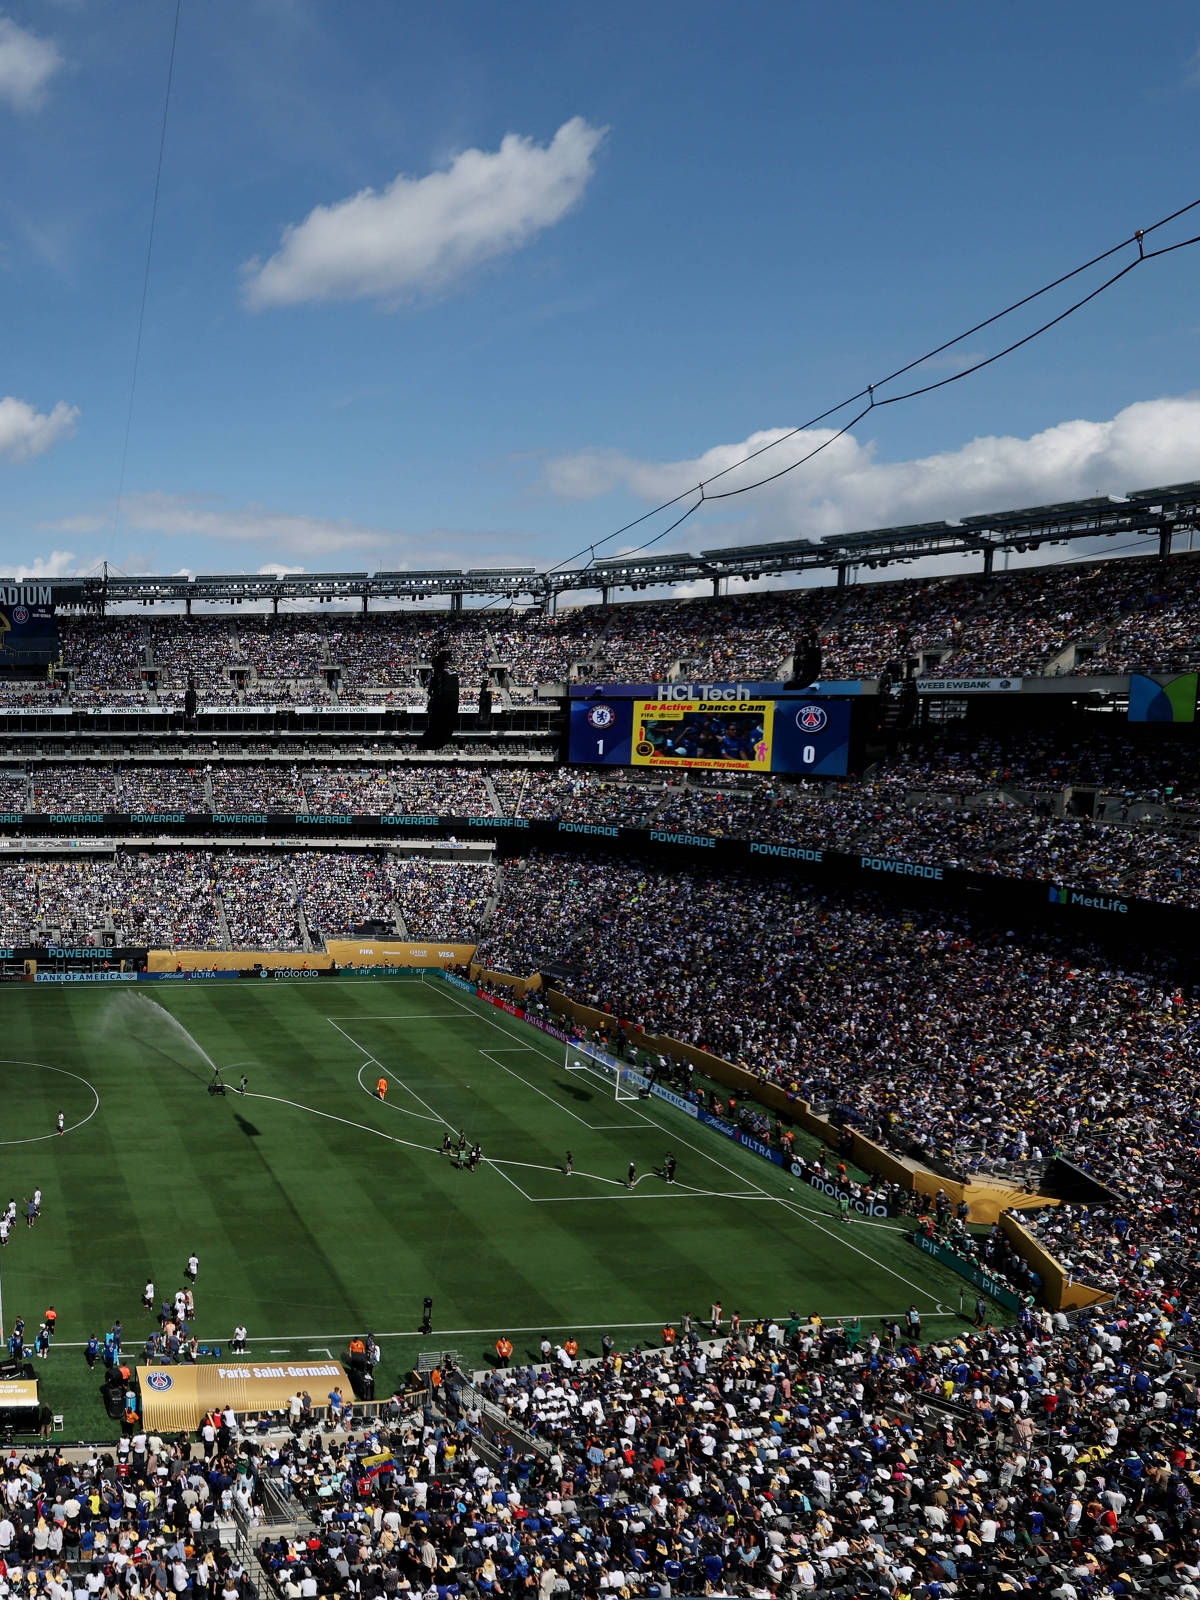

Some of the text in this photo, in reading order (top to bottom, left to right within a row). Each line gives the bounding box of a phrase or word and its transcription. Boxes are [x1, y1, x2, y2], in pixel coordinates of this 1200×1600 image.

[917, 680, 991, 689] WEEB EWBANK
[657, 684, 751, 701] HCLTech
[643, 703, 766, 711] Be Active Dance Cam
[596, 739, 604, 755] 1
[802, 745, 815, 764] 0
[49, 814, 105, 824] POWERADE
[130, 813, 185, 824] POWERADE
[211, 813, 268, 824] POWERADE
[295, 815, 353, 825] POWERADE
[380, 815, 440, 826] POWERADE
[467, 816, 530, 828] POWERADE
[558, 822, 620, 837] POWERADE
[650, 831, 717, 848] POWERADE
[749, 842, 823, 862] POWERADE
[860, 857, 944, 880] POWERADE
[1070, 892, 1128, 914] MetLife
[49, 948, 113, 958] POWERADE
[36, 973, 60, 981] BANK
[71, 972, 122, 980] AMERICA
[191, 971, 216, 979] ULTRA
[274, 969, 319, 977] motorola
[445, 973, 470, 993] Hisense
[524, 1013, 569, 1042] QATAR AIRWAYS
[656, 1089, 688, 1110] AMERICA
[741, 1133, 773, 1159] ULTRA
[921, 1238, 940, 1255] PIF
[982, 1277, 1001, 1297] PIF
[218, 1365, 341, 1379] Paris Saint-Germain
